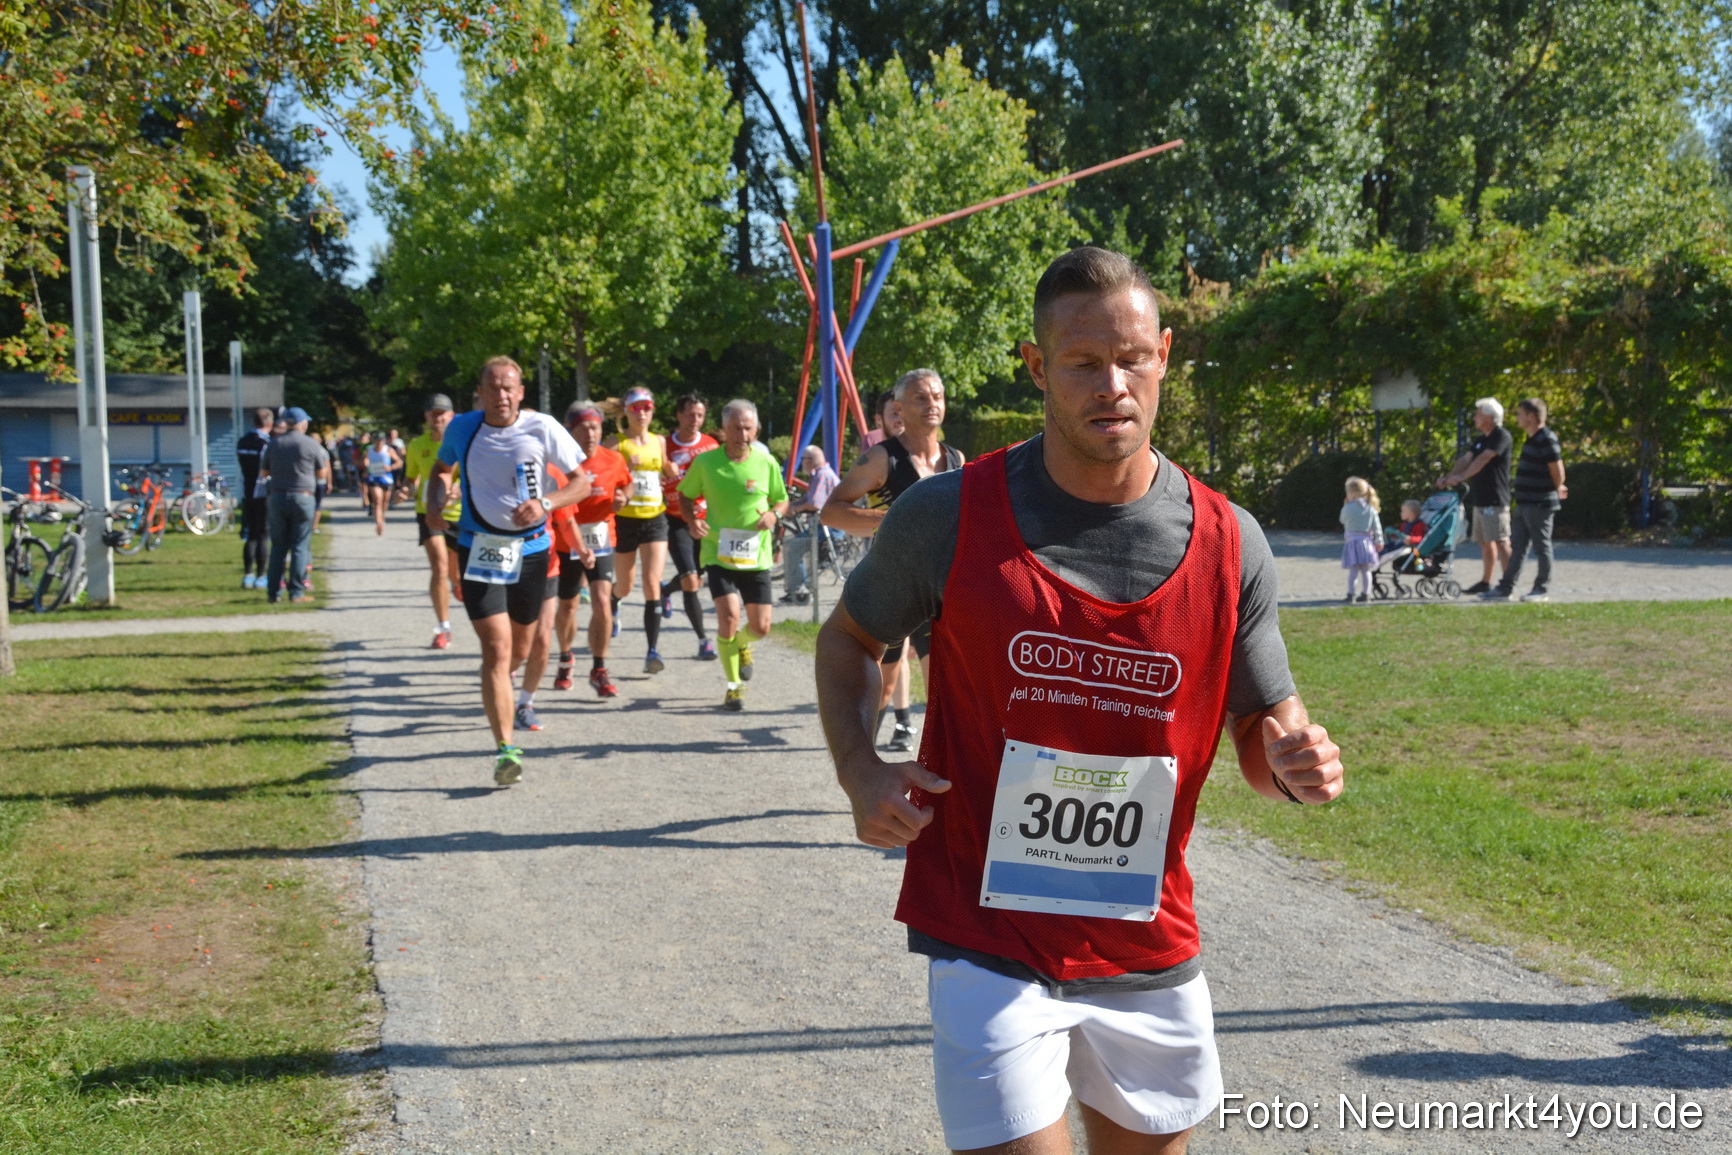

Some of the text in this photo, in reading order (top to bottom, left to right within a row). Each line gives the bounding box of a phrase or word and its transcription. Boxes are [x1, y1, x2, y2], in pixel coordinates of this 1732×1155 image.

[478, 547, 513, 564] 2654
[729, 540, 750, 553] 164
[1020, 642, 1172, 686] BODY STREET
[1031, 687, 1044, 701] 20
[1048, 689, 1088, 707] Minuten
[1092, 696, 1131, 716] Training
[1053, 766, 1129, 787] BOCK
[1018, 792, 1144, 848] 3060
[1000, 826, 1007, 836] C
[1025, 847, 1062, 861] PARTL
[1064, 853, 1113, 865] Neumarkt
